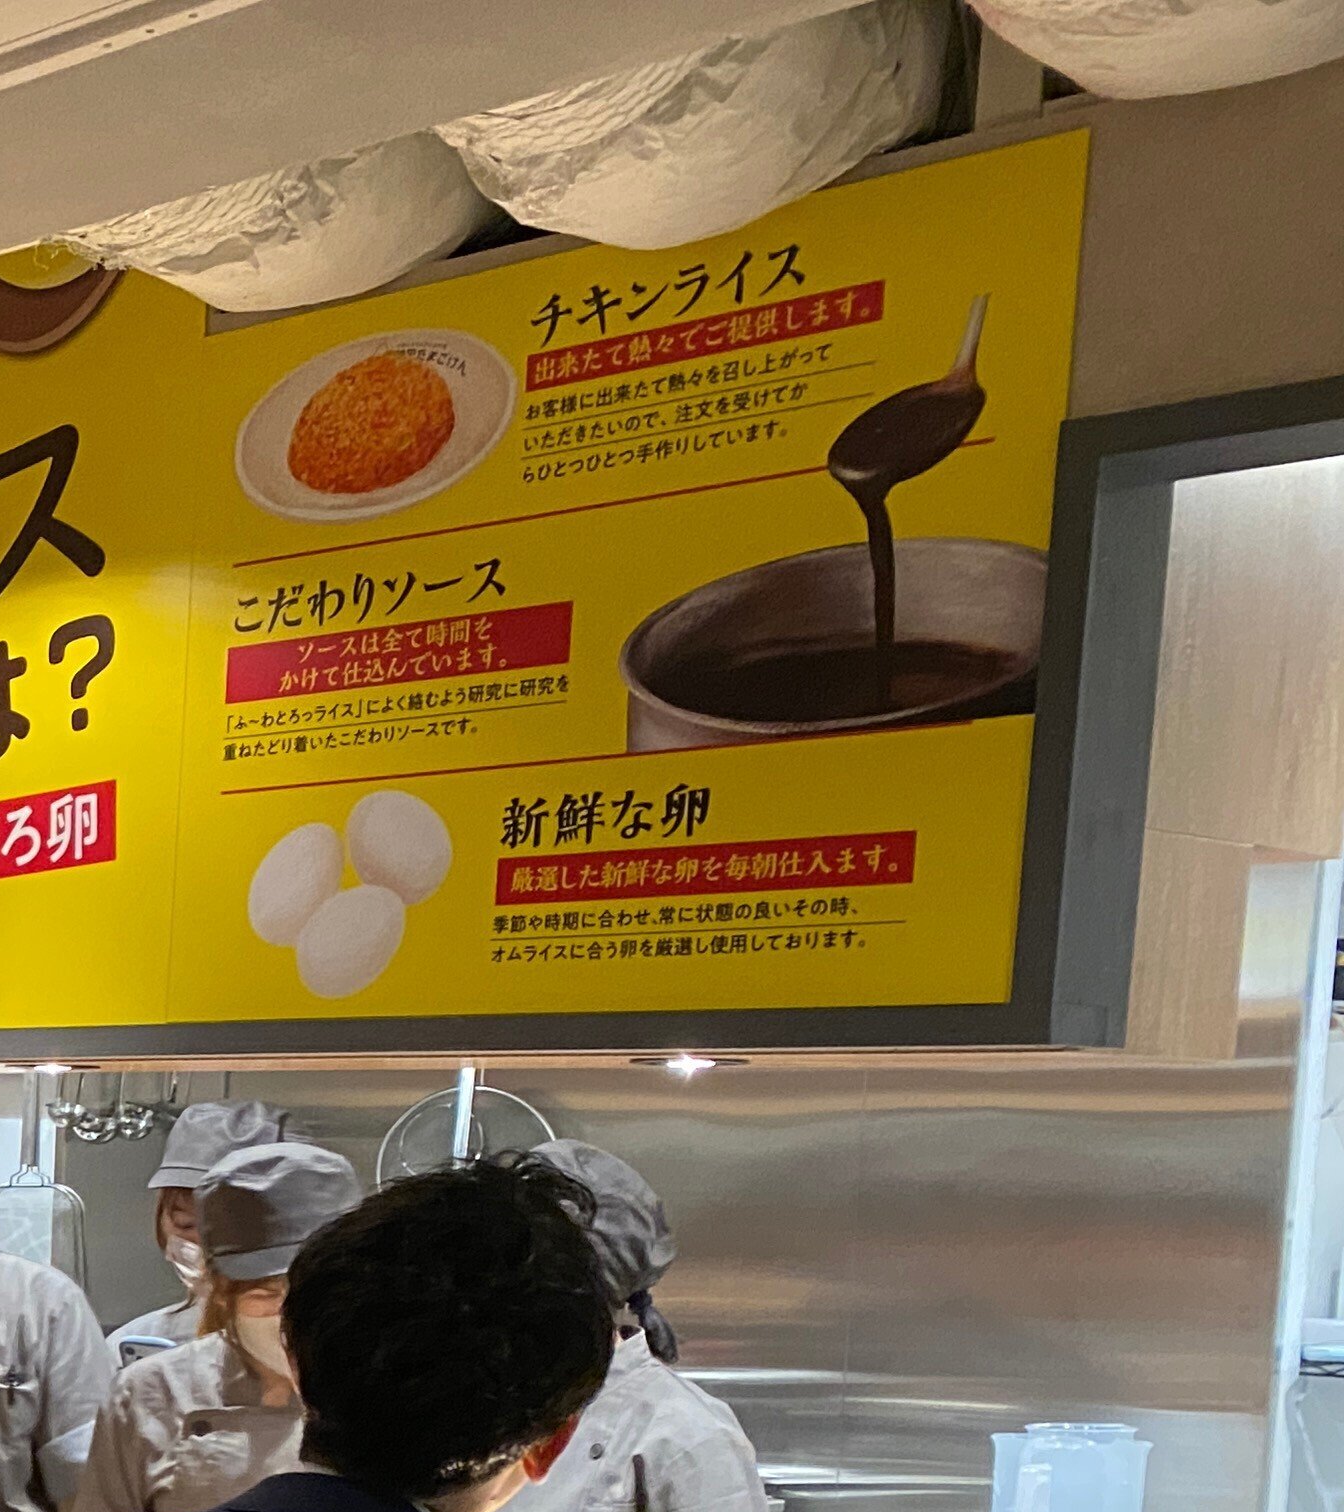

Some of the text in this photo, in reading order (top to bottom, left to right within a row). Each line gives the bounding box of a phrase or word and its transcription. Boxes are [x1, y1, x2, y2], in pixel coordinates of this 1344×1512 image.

[530, 244, 806, 349] チキンライス
[535, 291, 873, 384] 出来たて熱々でご提供します。
[525, 343, 833, 421] お客様に出来たて熱々を召し上がって
[524, 382, 809, 451] いただきたいので、注文を受けてか
[522, 420, 789, 483] らひとつひとつ手作りしています。
[235, 558, 506, 634] こだわりソース
[278, 644, 509, 692] かけて仕込んでいます。
[298, 616, 493, 663] ソースは全て時間を
[223, 718, 478, 761] 重ねたどり着いたこだわりソースです。
[499, 783, 712, 849] 新鮮な卵
[510, 843, 900, 894] 厳選した新鮮な卵を毎朝仕入ます。
[491, 929, 867, 964] オムライスに合う卵を厳選し使用しております。
[492, 896, 859, 934] 季節や時期に合わせ、常に状態の良いその時、
